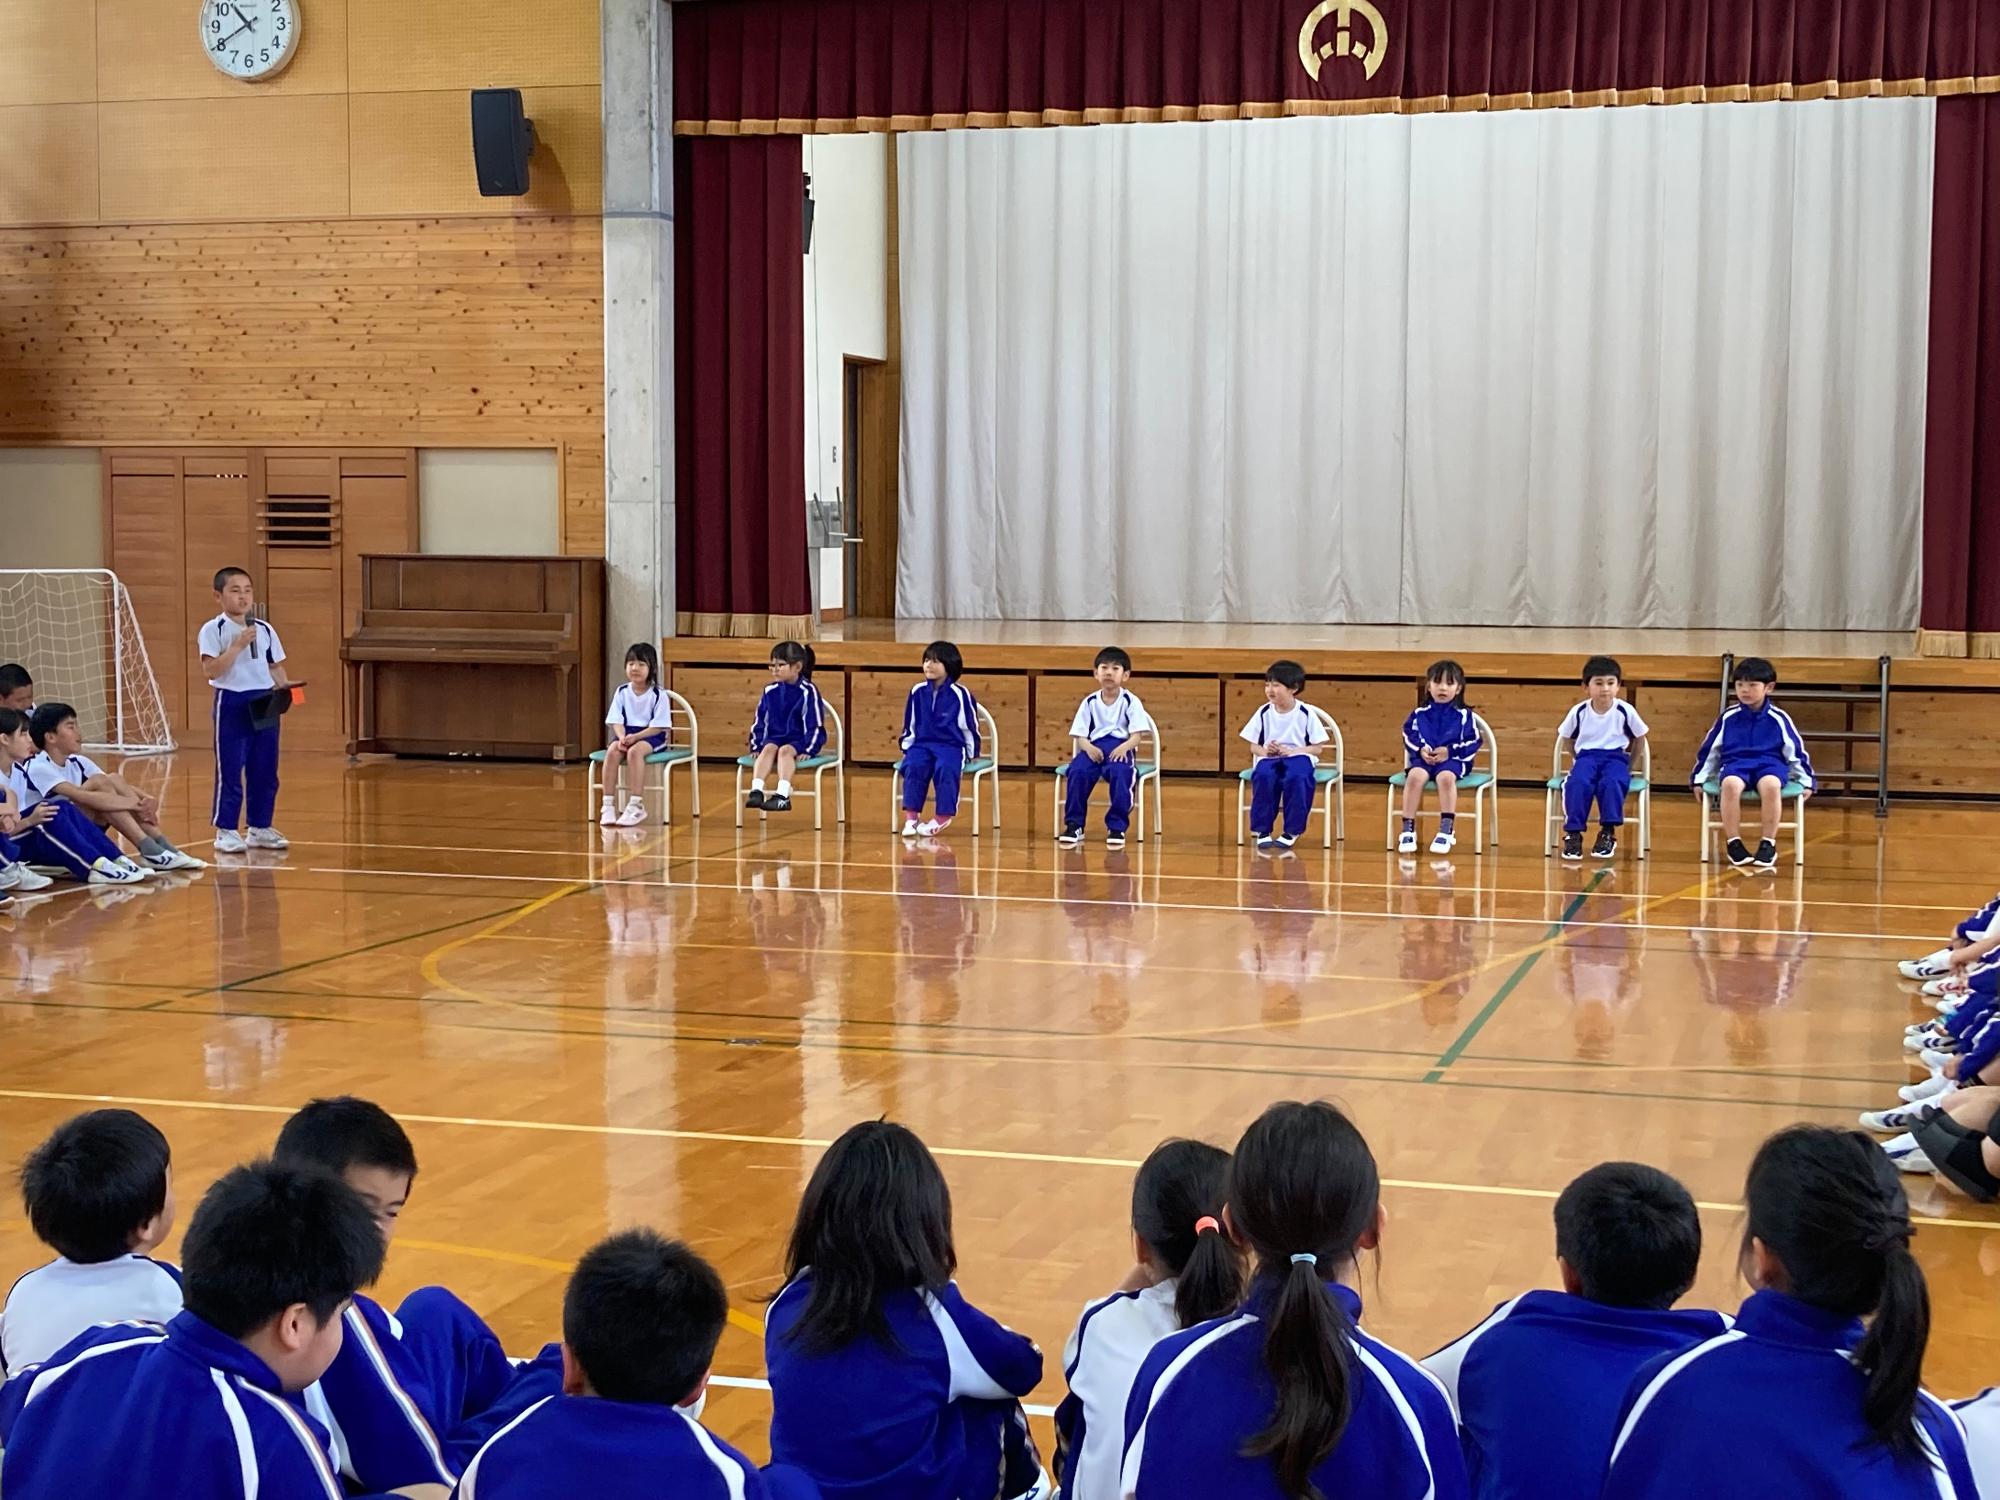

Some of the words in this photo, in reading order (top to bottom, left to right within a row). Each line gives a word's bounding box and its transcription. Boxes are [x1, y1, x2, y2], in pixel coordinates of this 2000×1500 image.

[215, 2, 230, 17] 10
[271, 0, 281, 12] 2
[211, 20, 221, 33] 9
[276, 16, 286, 31] 3
[216, 38, 227, 51] 8
[271, 35, 281, 49] 4
[229, 50, 239, 64] 7
[244, 54, 254, 68] 6
[260, 49, 269, 62] 5
